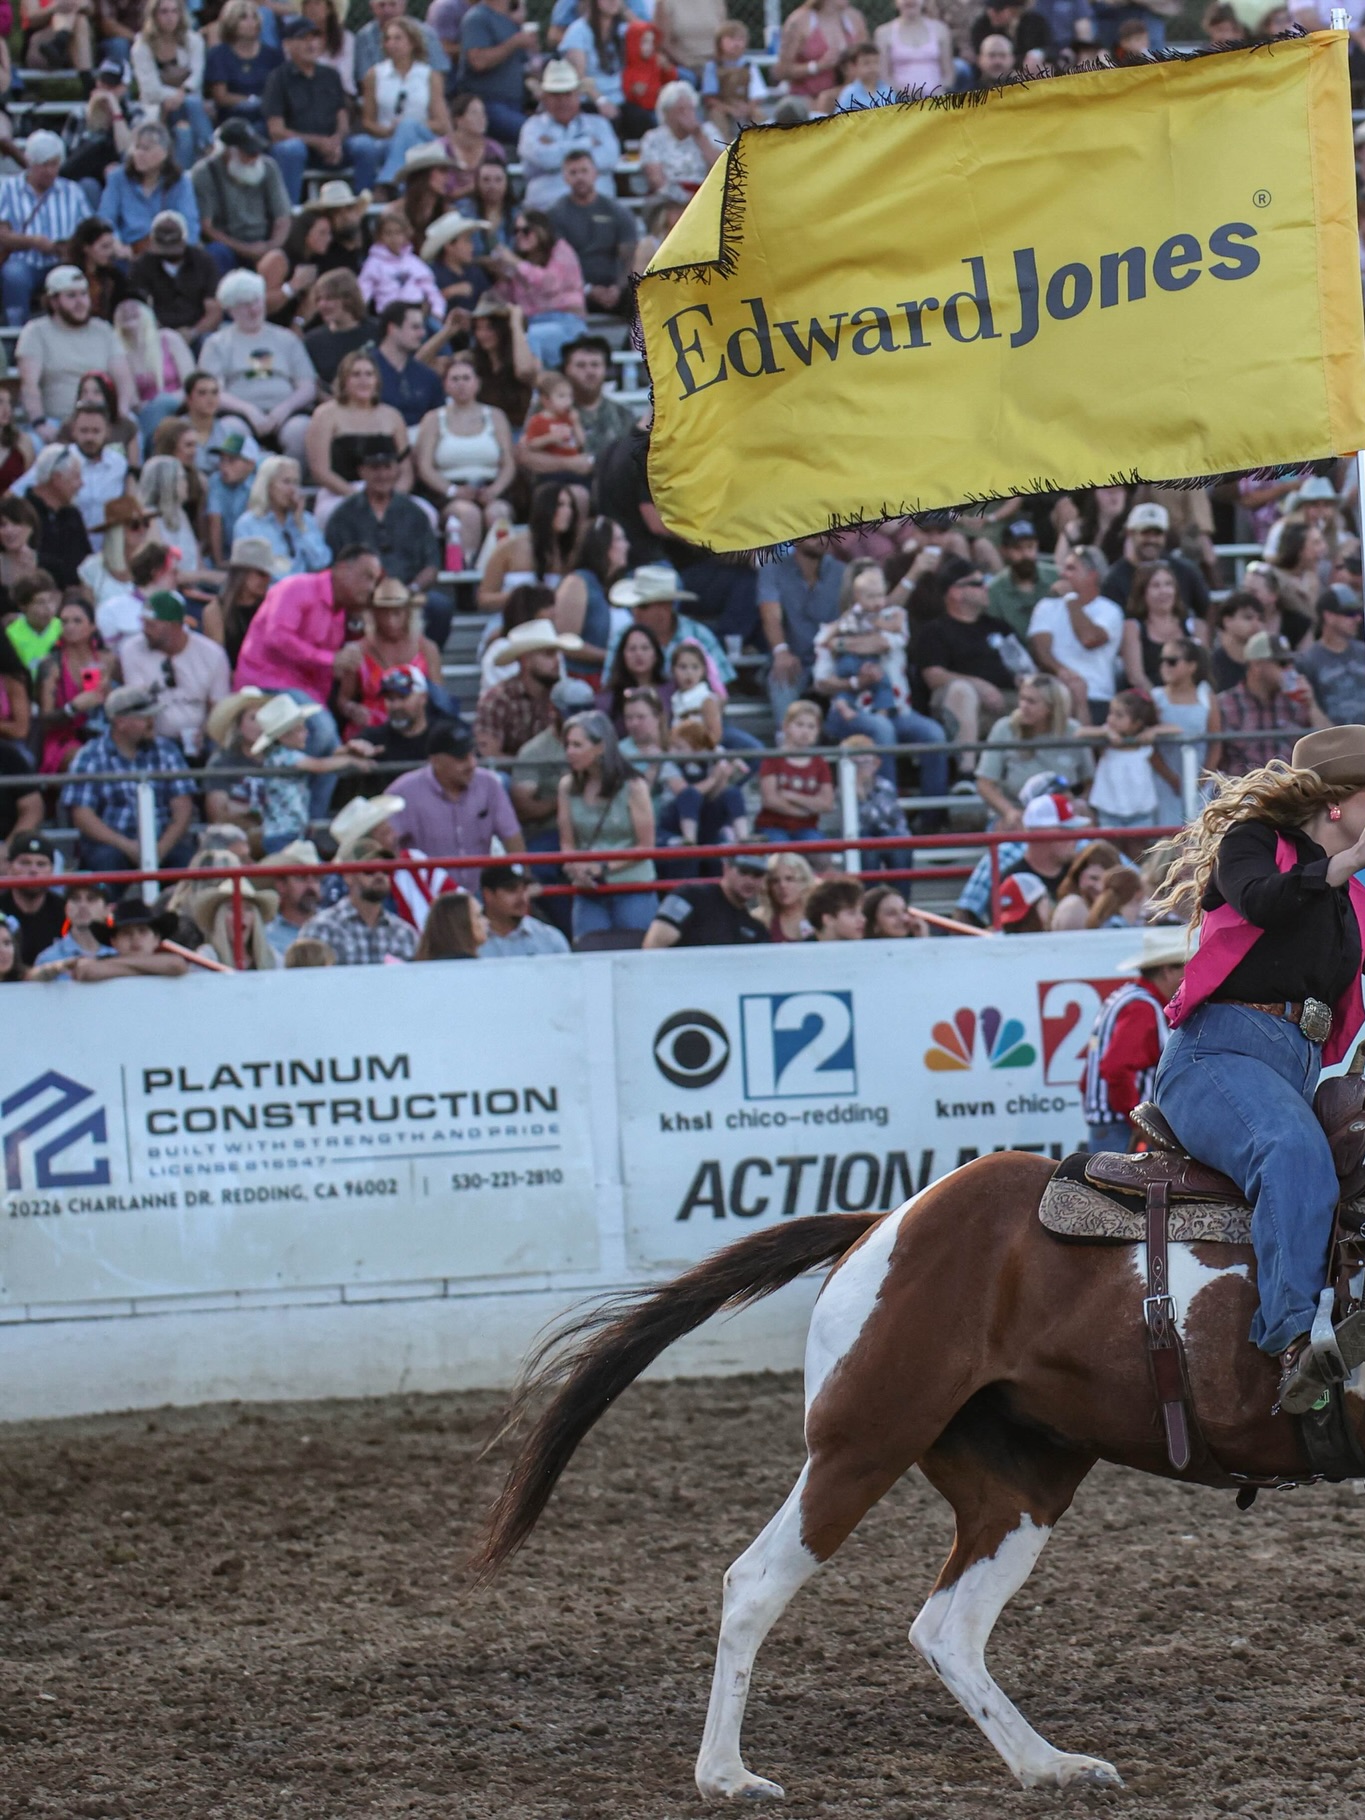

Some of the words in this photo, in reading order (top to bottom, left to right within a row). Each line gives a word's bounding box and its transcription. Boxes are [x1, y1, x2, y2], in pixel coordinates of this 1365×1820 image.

[661, 255, 1003, 401] Edward
[1010, 222, 1262, 349] Jones
[1042, 980, 1102, 1083] 2
[143, 1053, 411, 1095] PLATINUM
[146, 1086, 558, 1135] CONSTRUCTION
[660, 1111, 713, 1132] khsl
[725, 1103, 890, 1127] chico-redding
[935, 1099, 995, 1118] knvn
[1006, 1093, 1080, 1114] chico-
[148, 1143, 216, 1159] BUILT
[225, 1139, 287, 1154] WITH
[293, 1131, 425, 1149] STRENGTH
[432, 1126, 482, 1141] AND
[488, 1123, 561, 1136] PRIDE
[148, 1159, 241, 1178] LICENSE
[451, 1167, 564, 1191] 530-221-2810
[675, 1148, 934, 1221] ACTION
[68, 1191, 178, 1215] CHARLANNE
[314, 1182, 339, 1199] CA
[344, 1178, 398, 1198] 96002
